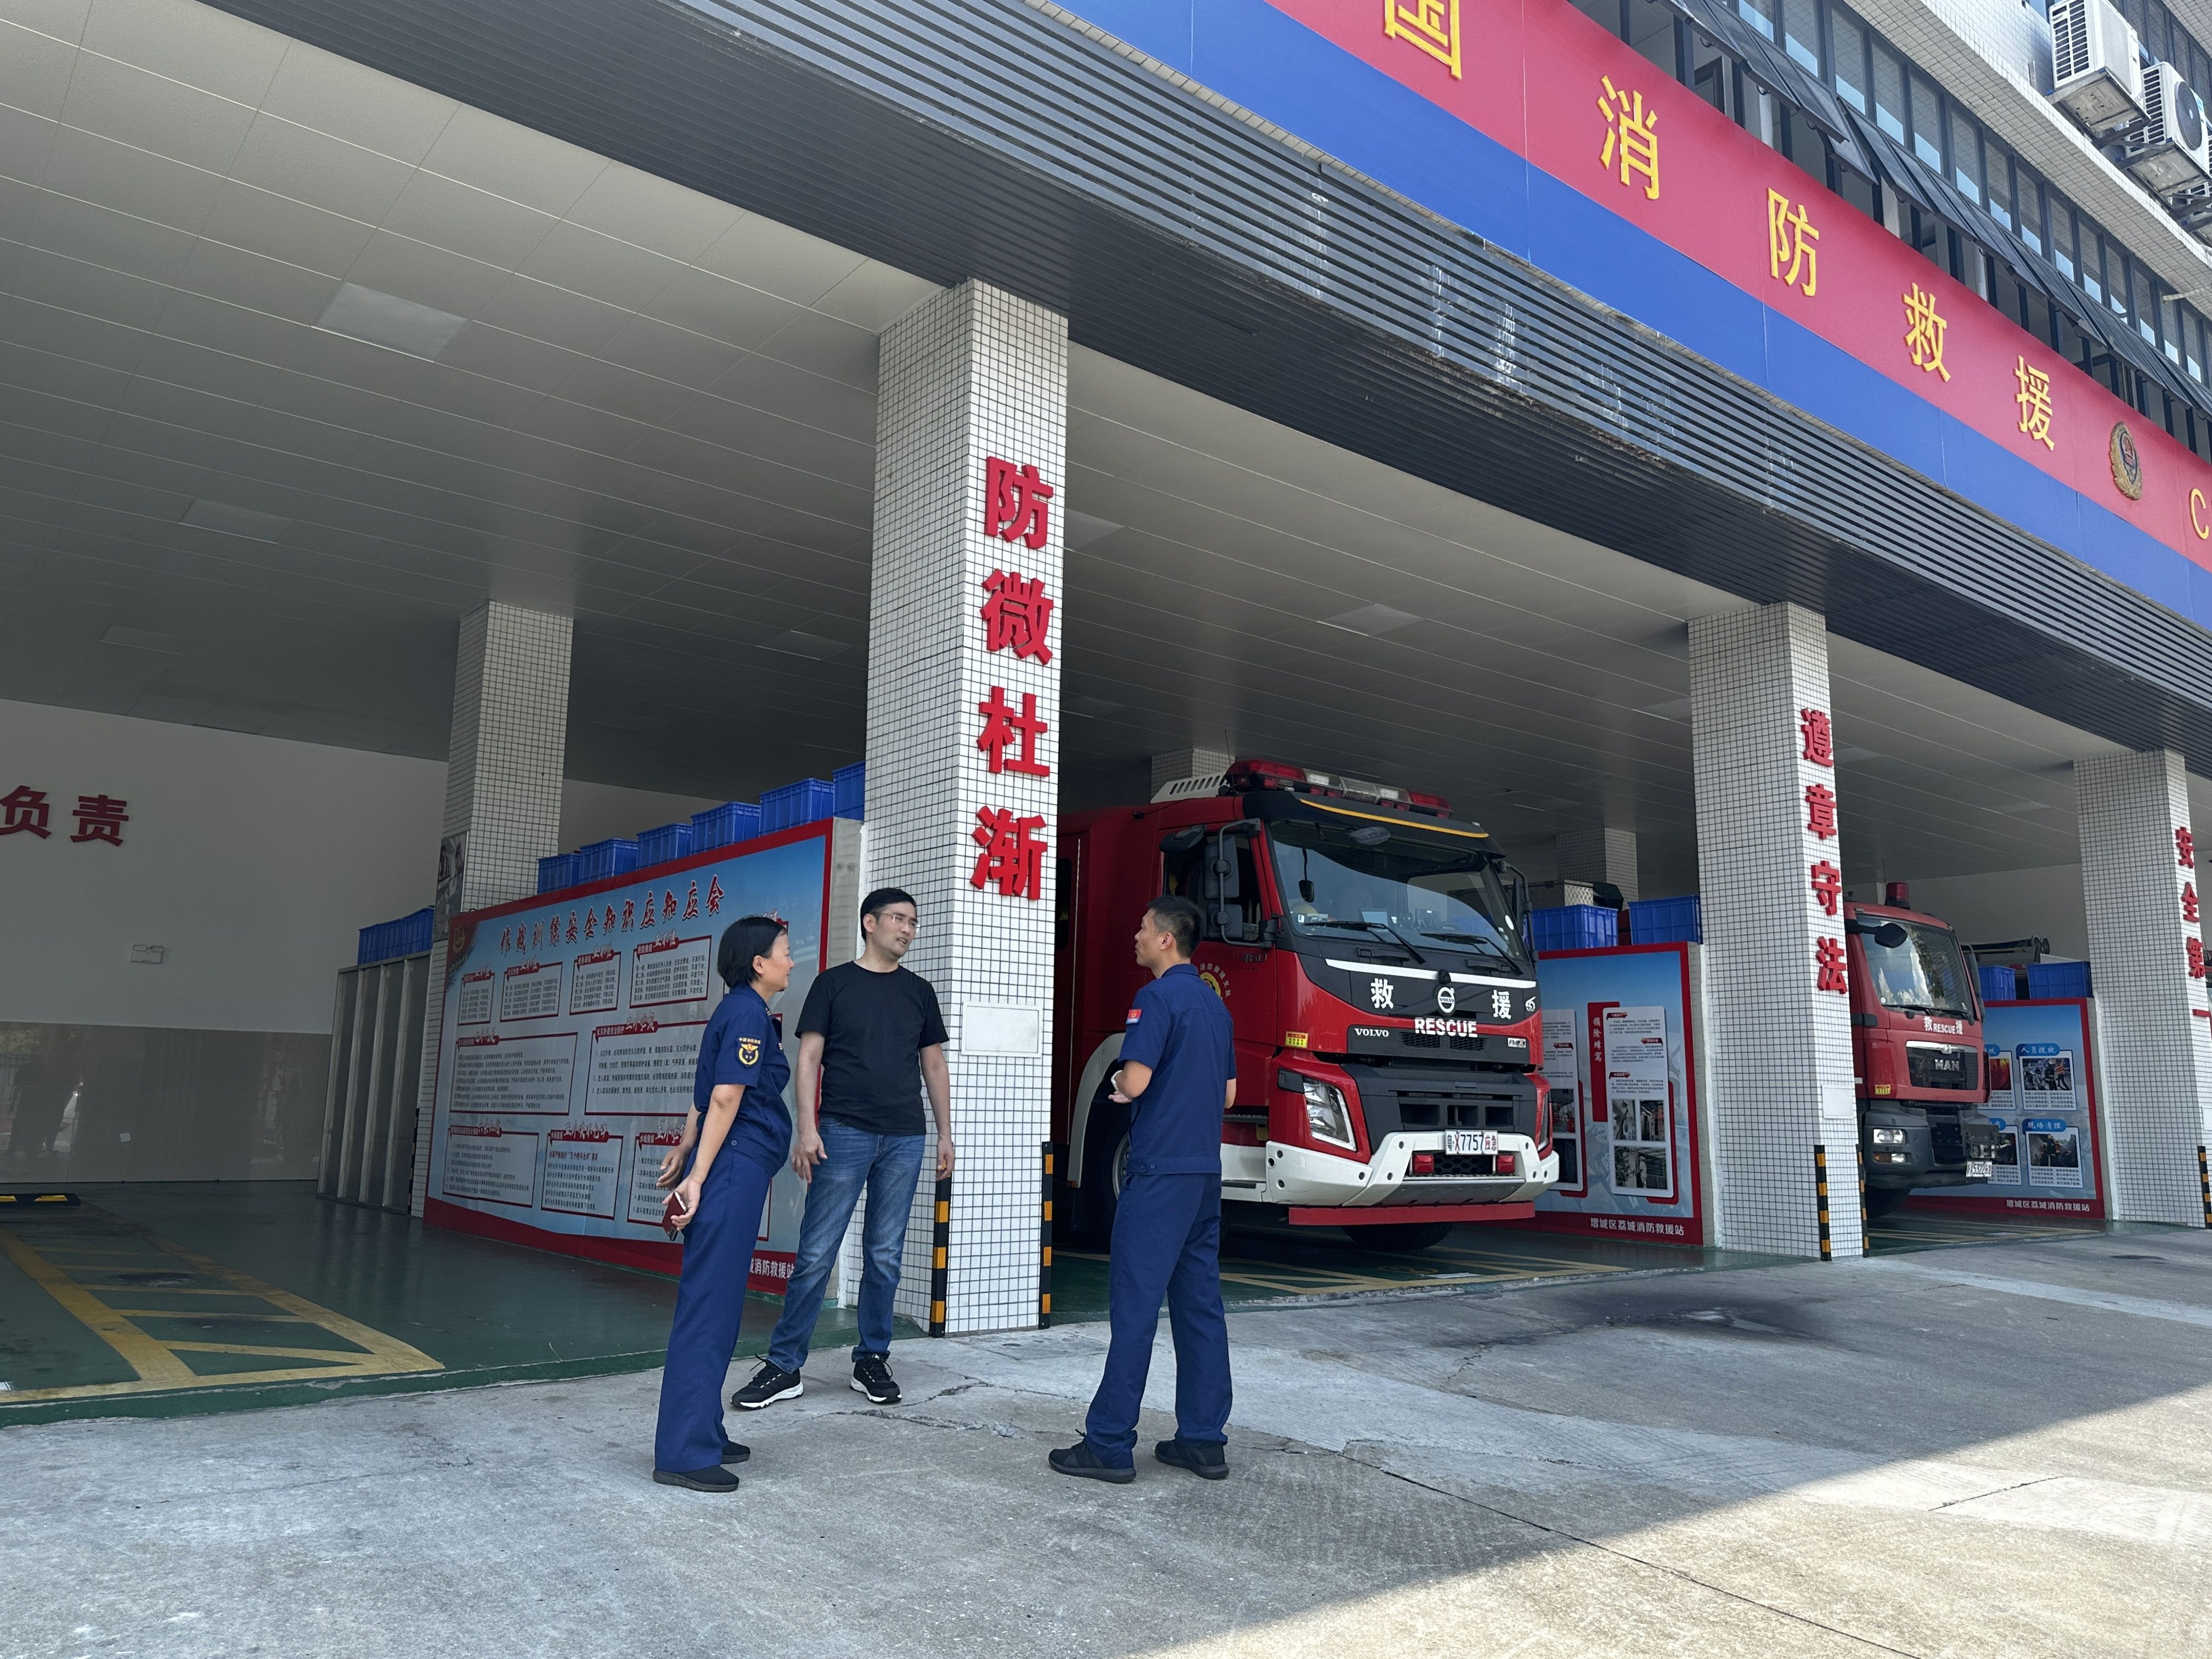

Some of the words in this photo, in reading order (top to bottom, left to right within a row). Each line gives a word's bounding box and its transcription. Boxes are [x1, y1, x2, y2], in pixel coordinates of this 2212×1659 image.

[970, 456, 1054, 900] 防微杜渐
[0, 785, 129, 847] 负责
[1801, 708, 1848, 995] 遵章守法
[500, 874, 725, 957] 作战训练安全知识应知应会
[2175, 827, 2210, 1018] 安全第一
[1370, 978, 1394, 1009] 救
[1492, 990, 1511, 1019] 援
[1354, 1028, 1389, 1037] VOLVO
[1414, 1017, 1479, 1037] RESCUE
[1593, 1016, 1602, 1063] 摘除蜂窝
[1933, 1023, 1955, 1034] RESCUE
[1934, 1059, 1960, 1071] MAN
[1590, 1217, 1685, 1235] 增城区荔城消防救援站
